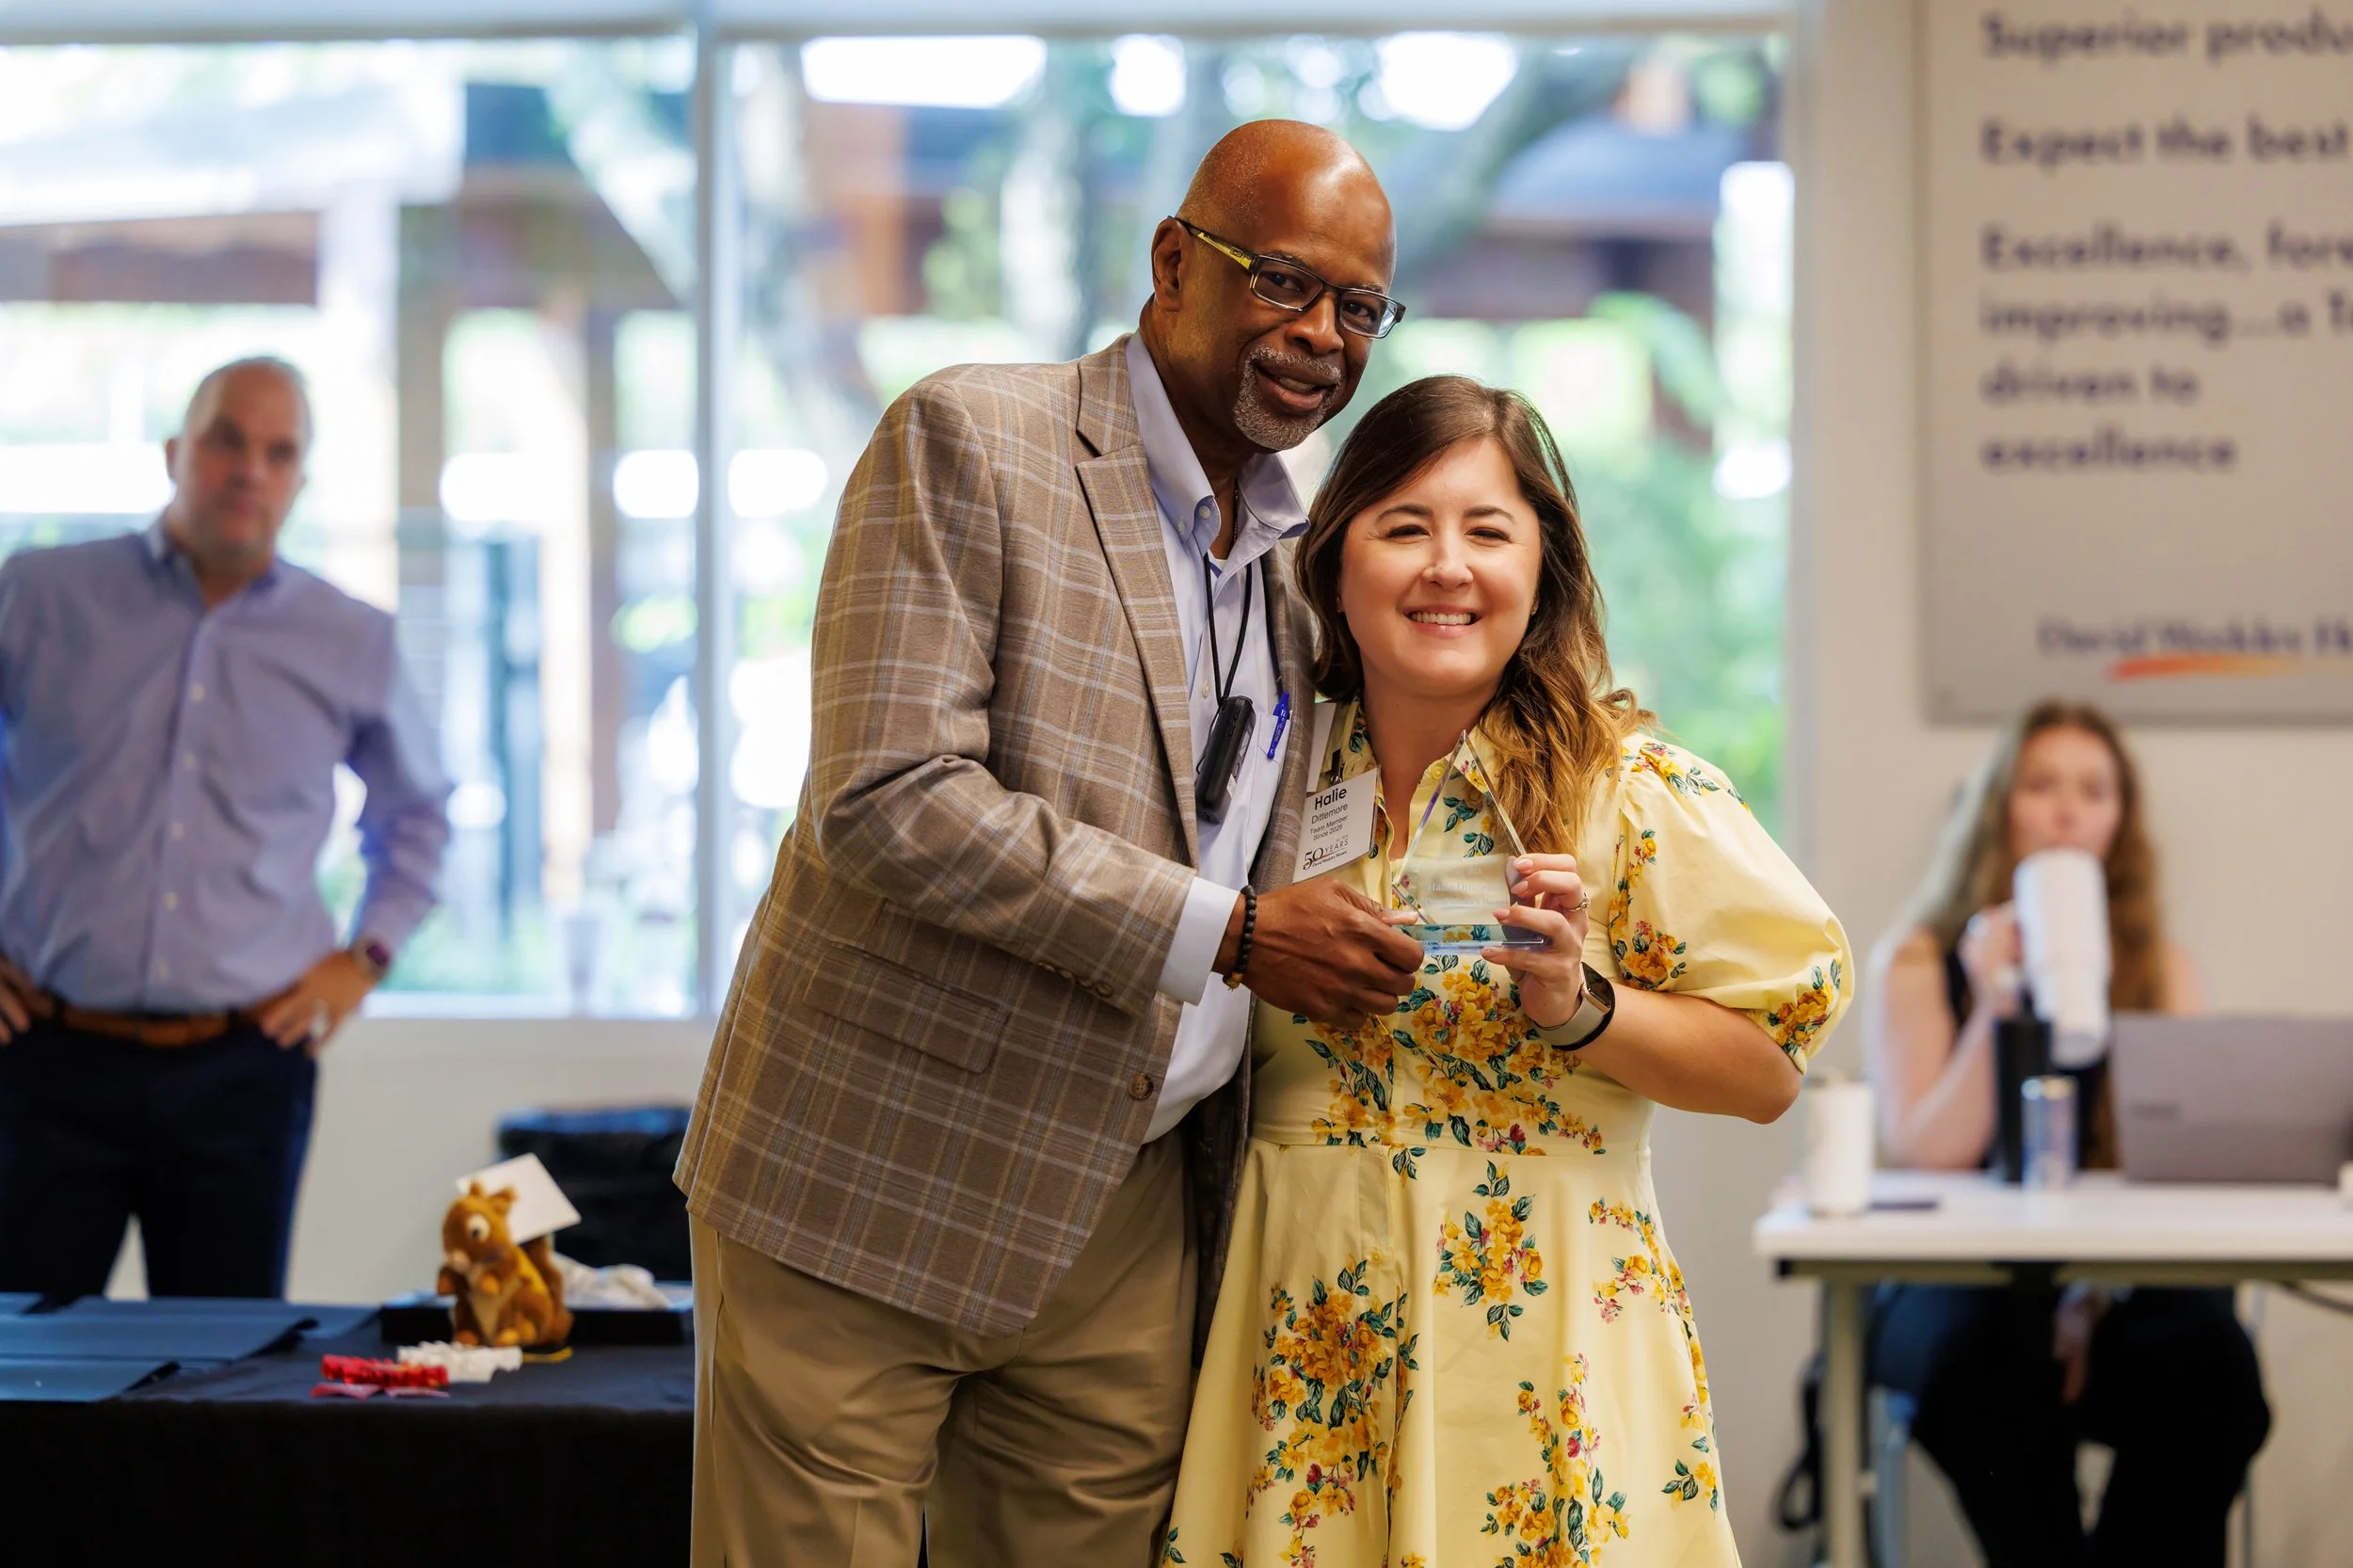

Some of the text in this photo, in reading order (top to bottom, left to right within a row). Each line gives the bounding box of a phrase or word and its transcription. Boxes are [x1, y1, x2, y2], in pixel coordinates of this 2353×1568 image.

[1981, 8, 2188, 69] Superior
[1981, 109, 2349, 175] Expect the best
[1981, 357, 2201, 407] driven to
[1981, 423, 2238, 473] excellence
[1311, 803, 1349, 824] Dittemore
[1314, 788, 1348, 810] Halie
[1309, 815, 1348, 835] Team Member
[1313, 831, 1329, 841] Since
[1303, 847, 1324, 871] 50
[1324, 838, 1349, 855] YEARS
